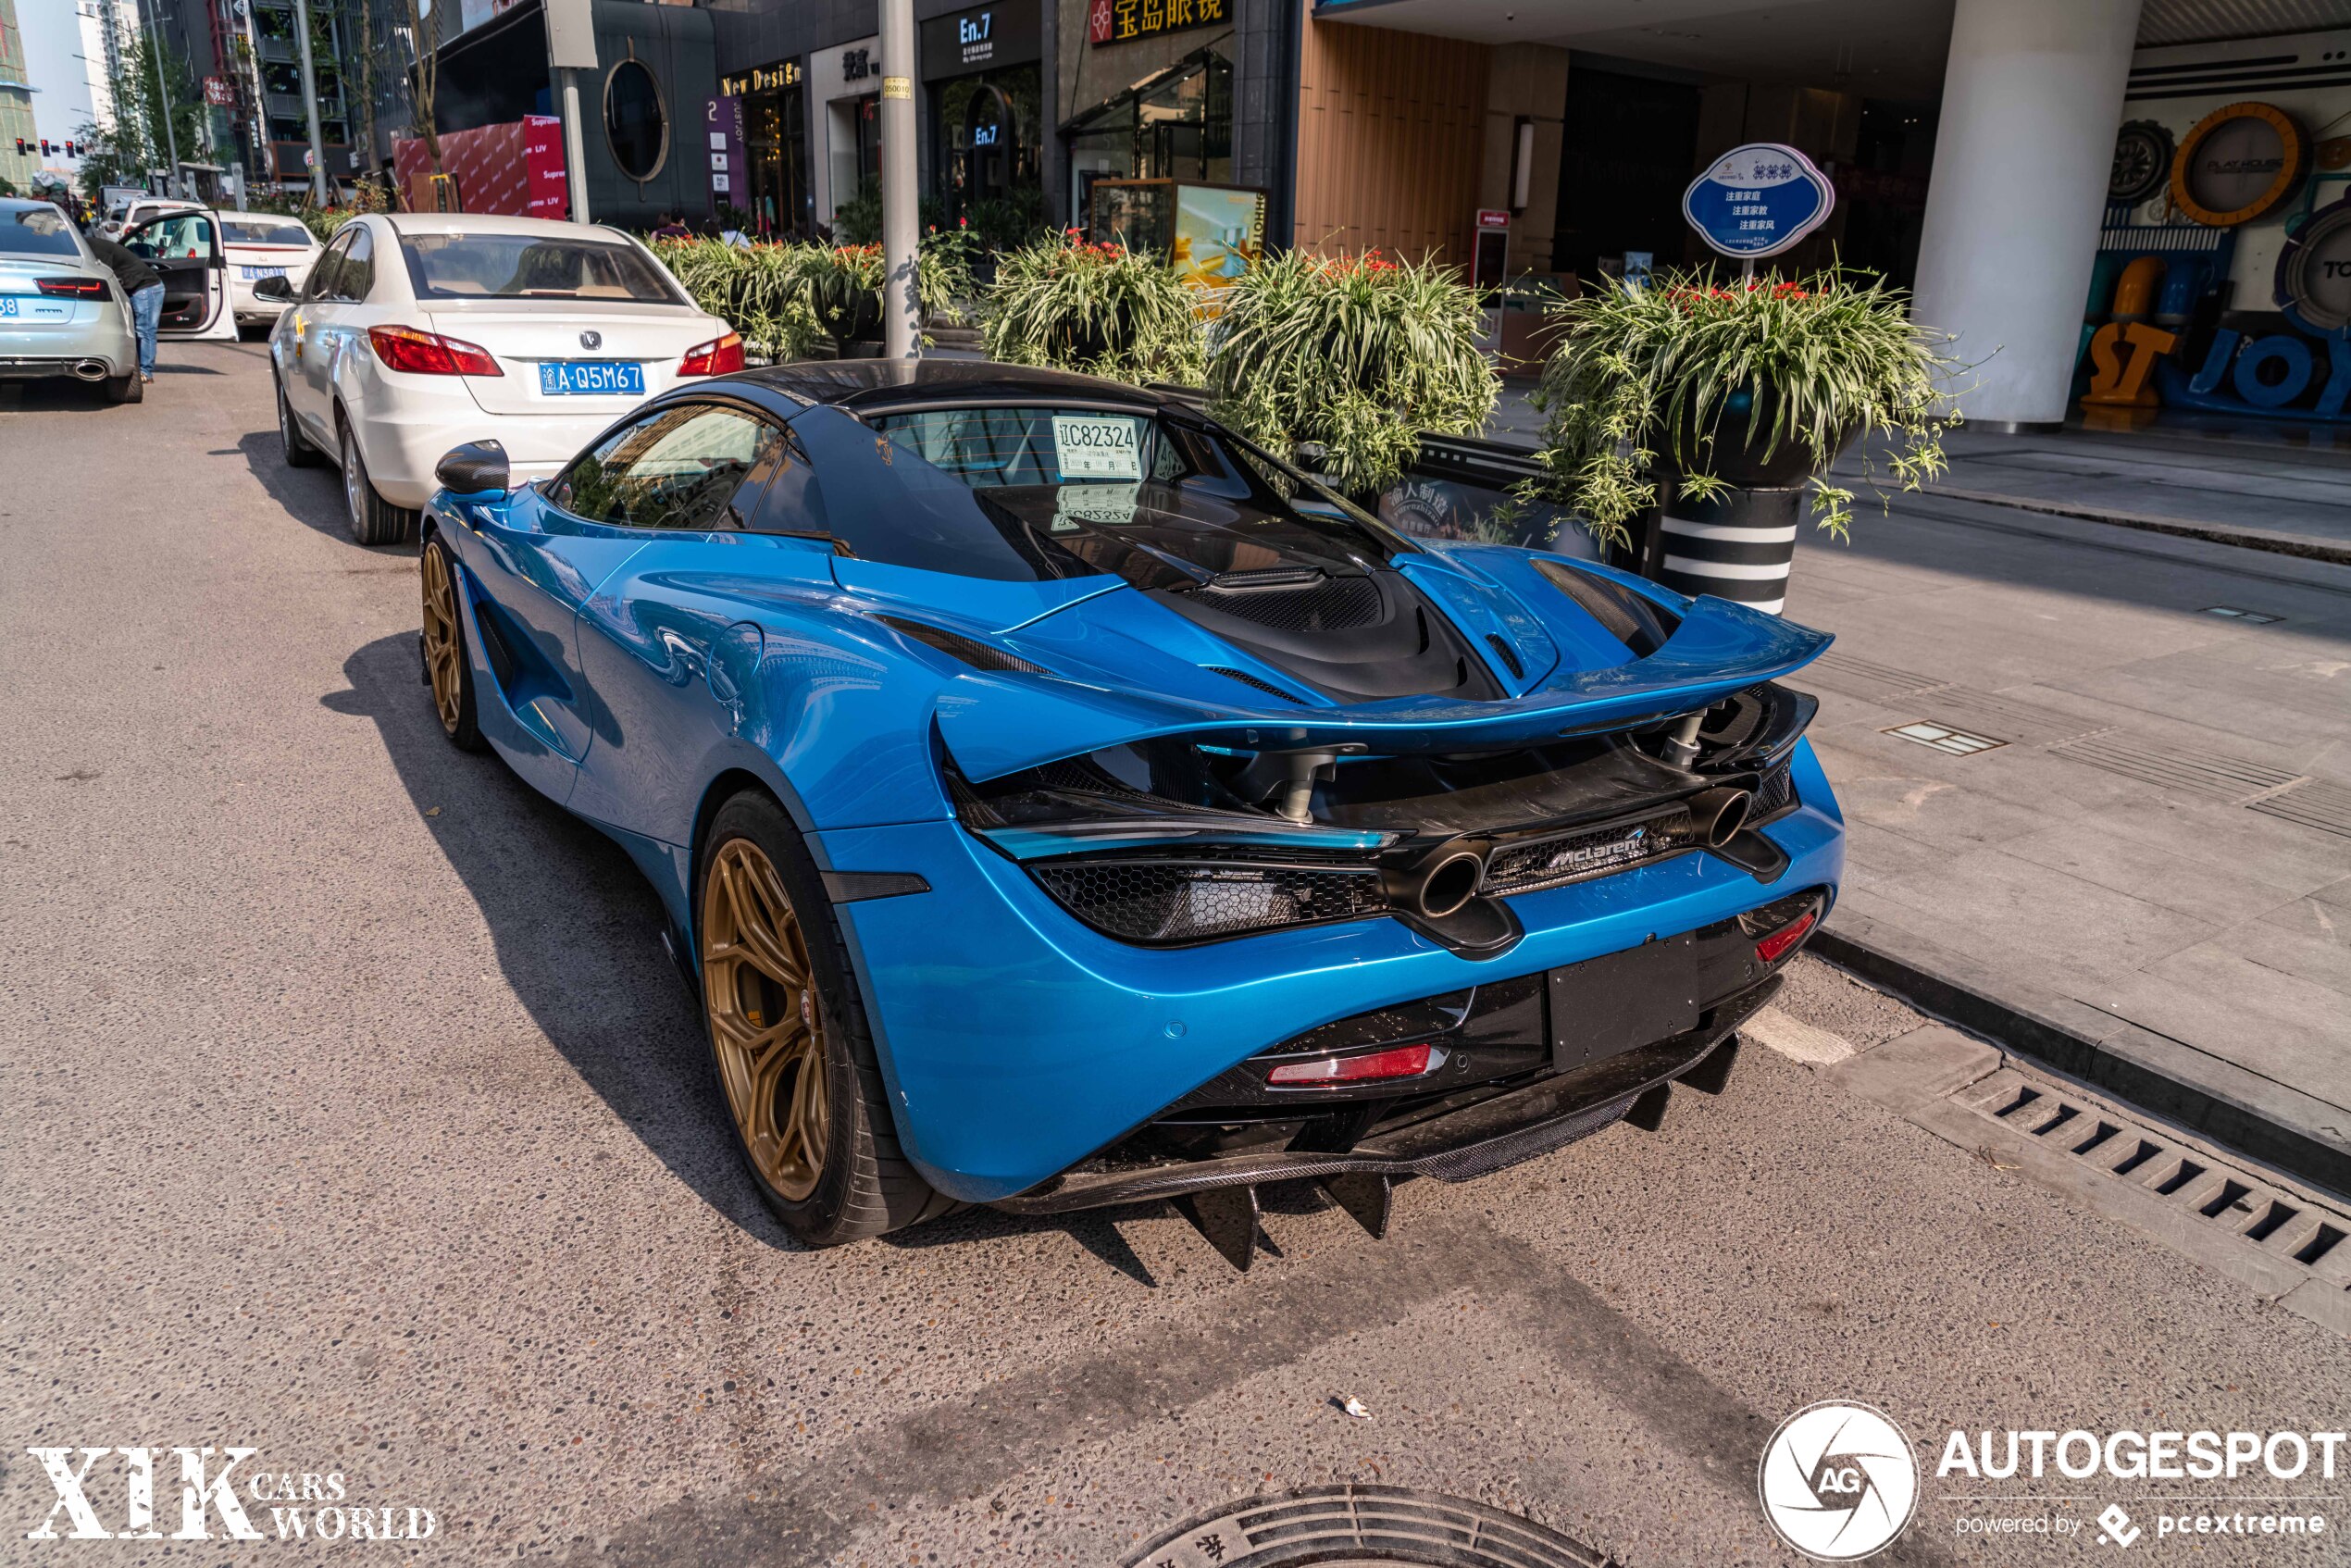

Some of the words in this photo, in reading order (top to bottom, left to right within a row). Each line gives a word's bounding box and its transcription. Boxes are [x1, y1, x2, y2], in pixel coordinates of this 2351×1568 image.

[960, 12, 991, 44] En.7
[1114, 0, 1223, 40] 宝岛眼镜
[723, 78, 748, 97] New
[753, 62, 802, 91] Design
[708, 101, 718, 121] 2
[975, 126, 997, 145] En.7
[1725, 191, 1761, 201] 注重家庭
[1732, 205, 1768, 216] 注重家教
[1739, 220, 1775, 230] 注重家风
[1548, 840, 1636, 868] McLaren
